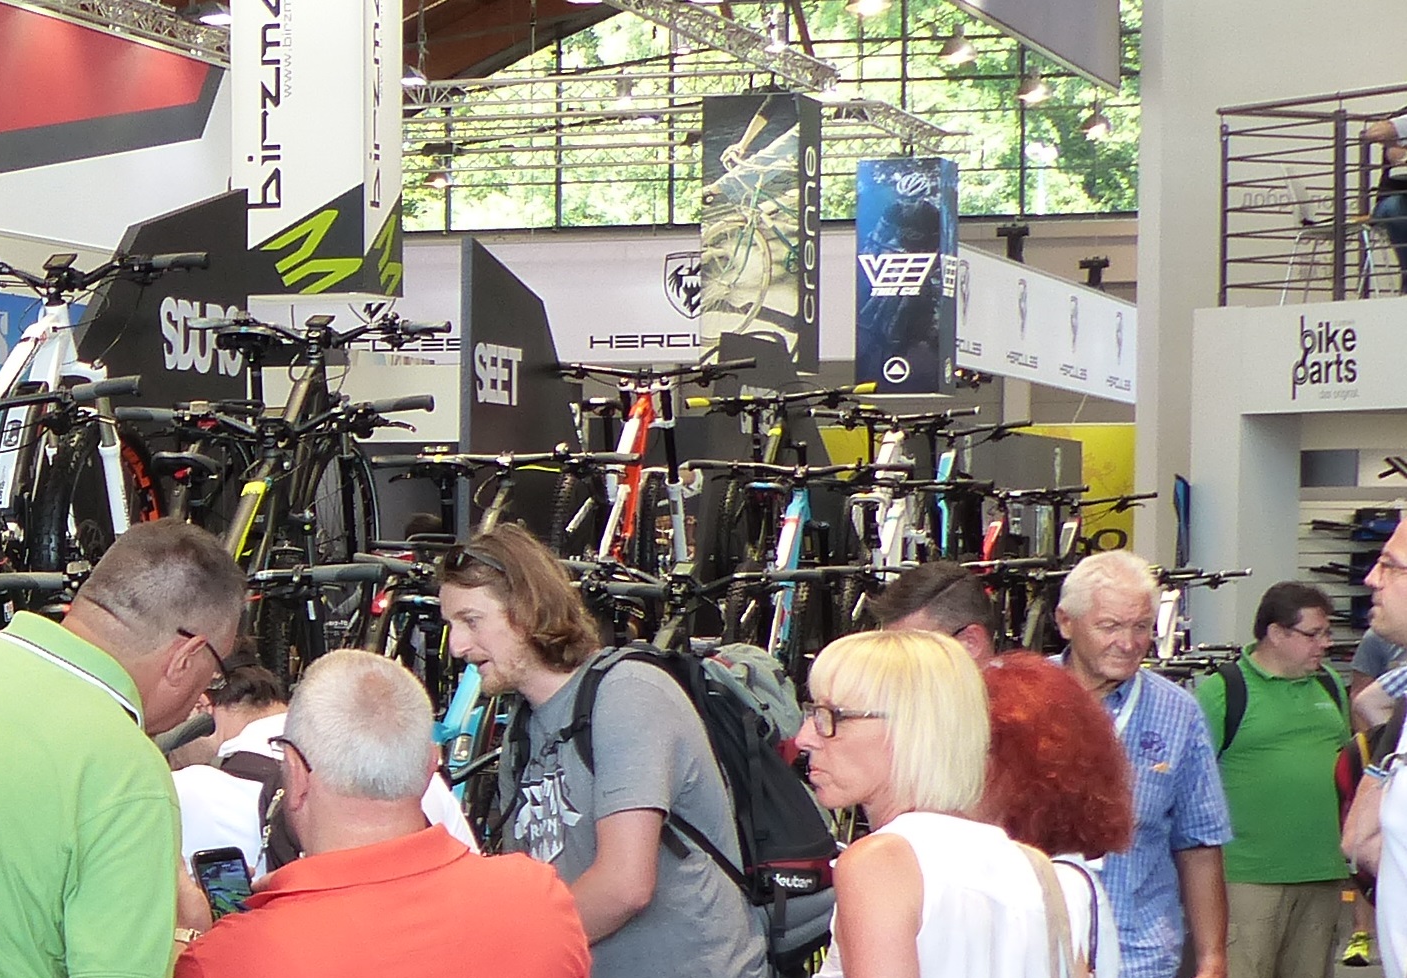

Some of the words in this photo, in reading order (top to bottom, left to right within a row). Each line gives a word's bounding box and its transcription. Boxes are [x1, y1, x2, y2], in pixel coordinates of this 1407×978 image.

[857, 253, 938, 288] VEE
[1300, 314, 1357, 355] bike
[474, 341, 523, 407] SEET
[1291, 353, 1357, 400] parts
